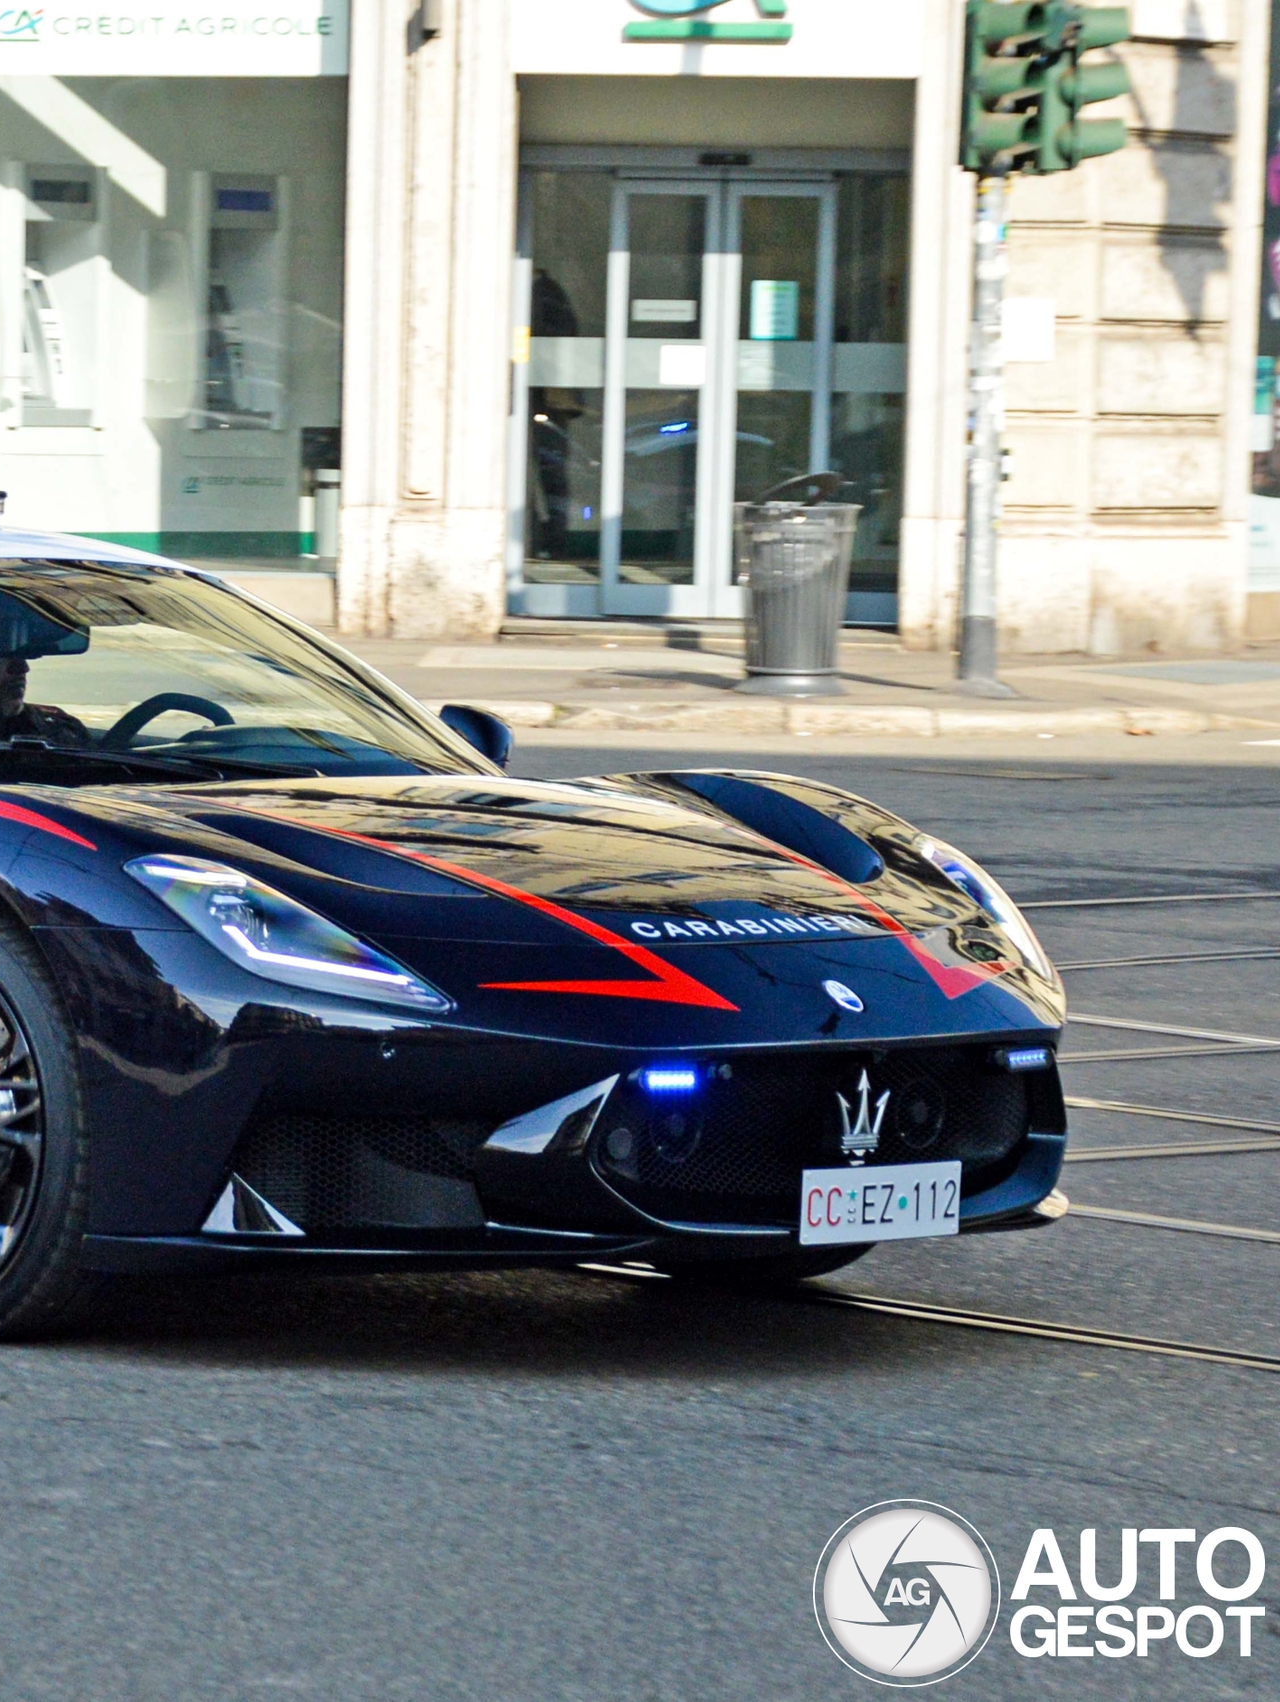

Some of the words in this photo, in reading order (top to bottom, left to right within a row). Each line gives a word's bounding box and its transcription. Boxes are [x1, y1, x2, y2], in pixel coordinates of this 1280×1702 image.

[173, 16, 335, 36] AGRICOLE
[630, 914, 872, 938] CARABINIERI
[807, 1187, 842, 1227] CC
[862, 1183, 895, 1224] EZ
[914, 1179, 957, 1221] 112
